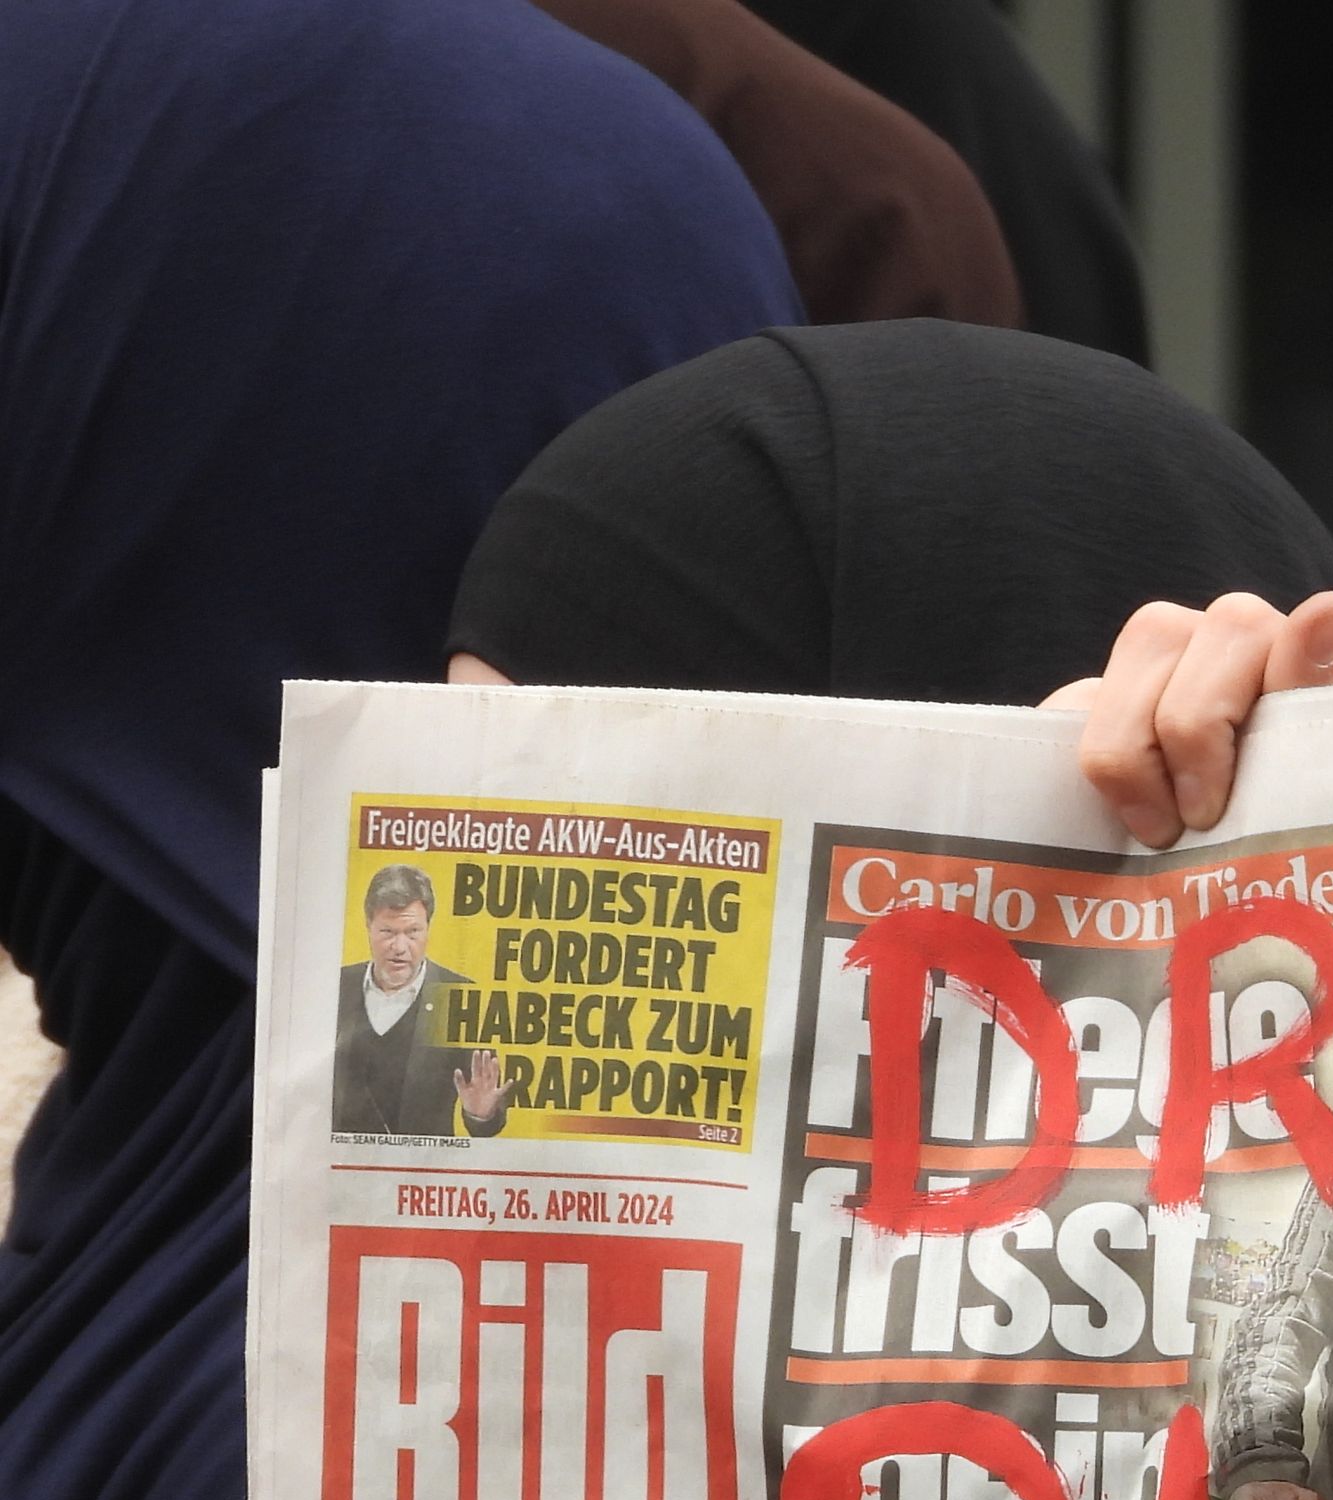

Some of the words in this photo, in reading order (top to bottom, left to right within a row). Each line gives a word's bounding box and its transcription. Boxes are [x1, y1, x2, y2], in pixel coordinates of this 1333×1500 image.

[367, 809, 532, 854] Freigeklagte
[537, 817, 762, 870] AKW-Aus-Akten
[452, 863, 741, 933] BUNDESTAG
[841, 856, 1035, 934] Carlo
[1054, 892, 1175, 944] von
[493, 928, 718, 993] FORDERT
[446, 989, 636, 1052] HABECK
[645, 1002, 753, 1060] ZUM
[507, 1054, 747, 1122] RAPPORT!
[353, 1135, 376, 1145] SEAN
[439, 1138, 471, 1149] IMAGES
[698, 1124, 727, 1142] Seite
[729, 1127, 739, 1143] 2
[397, 1184, 496, 1225] FREITAG,
[503, 1188, 539, 1220] 26.
[545, 1189, 609, 1224] APRIL
[617, 1193, 675, 1226] 2024
